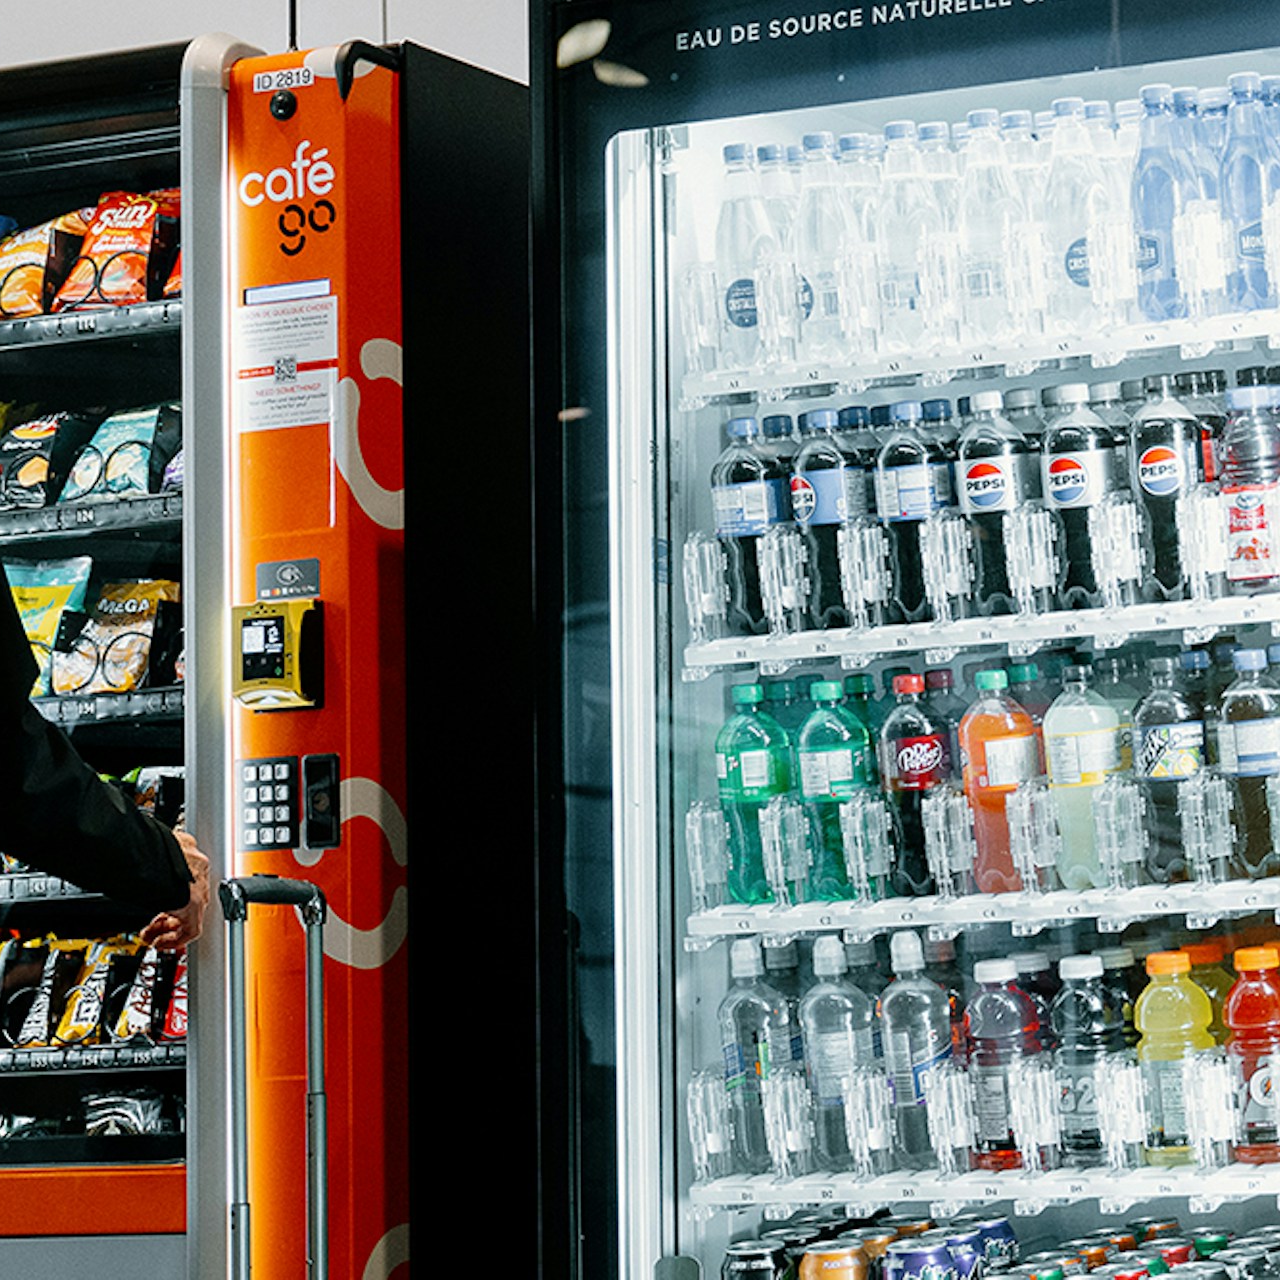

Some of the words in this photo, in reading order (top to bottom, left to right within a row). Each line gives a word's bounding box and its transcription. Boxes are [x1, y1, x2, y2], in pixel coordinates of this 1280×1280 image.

[676, 28, 721, 50] EAU
[731, 22, 760, 44] DE
[770, 8, 863, 39] SOURCE
[256, 74, 272, 90] ID
[276, 68, 312, 88] 2819
[239, 140, 335, 207] café
[278, 199, 336, 256] go
[966, 478, 1006, 492] PEPSI
[1049, 474, 1086, 487] PEPSI
